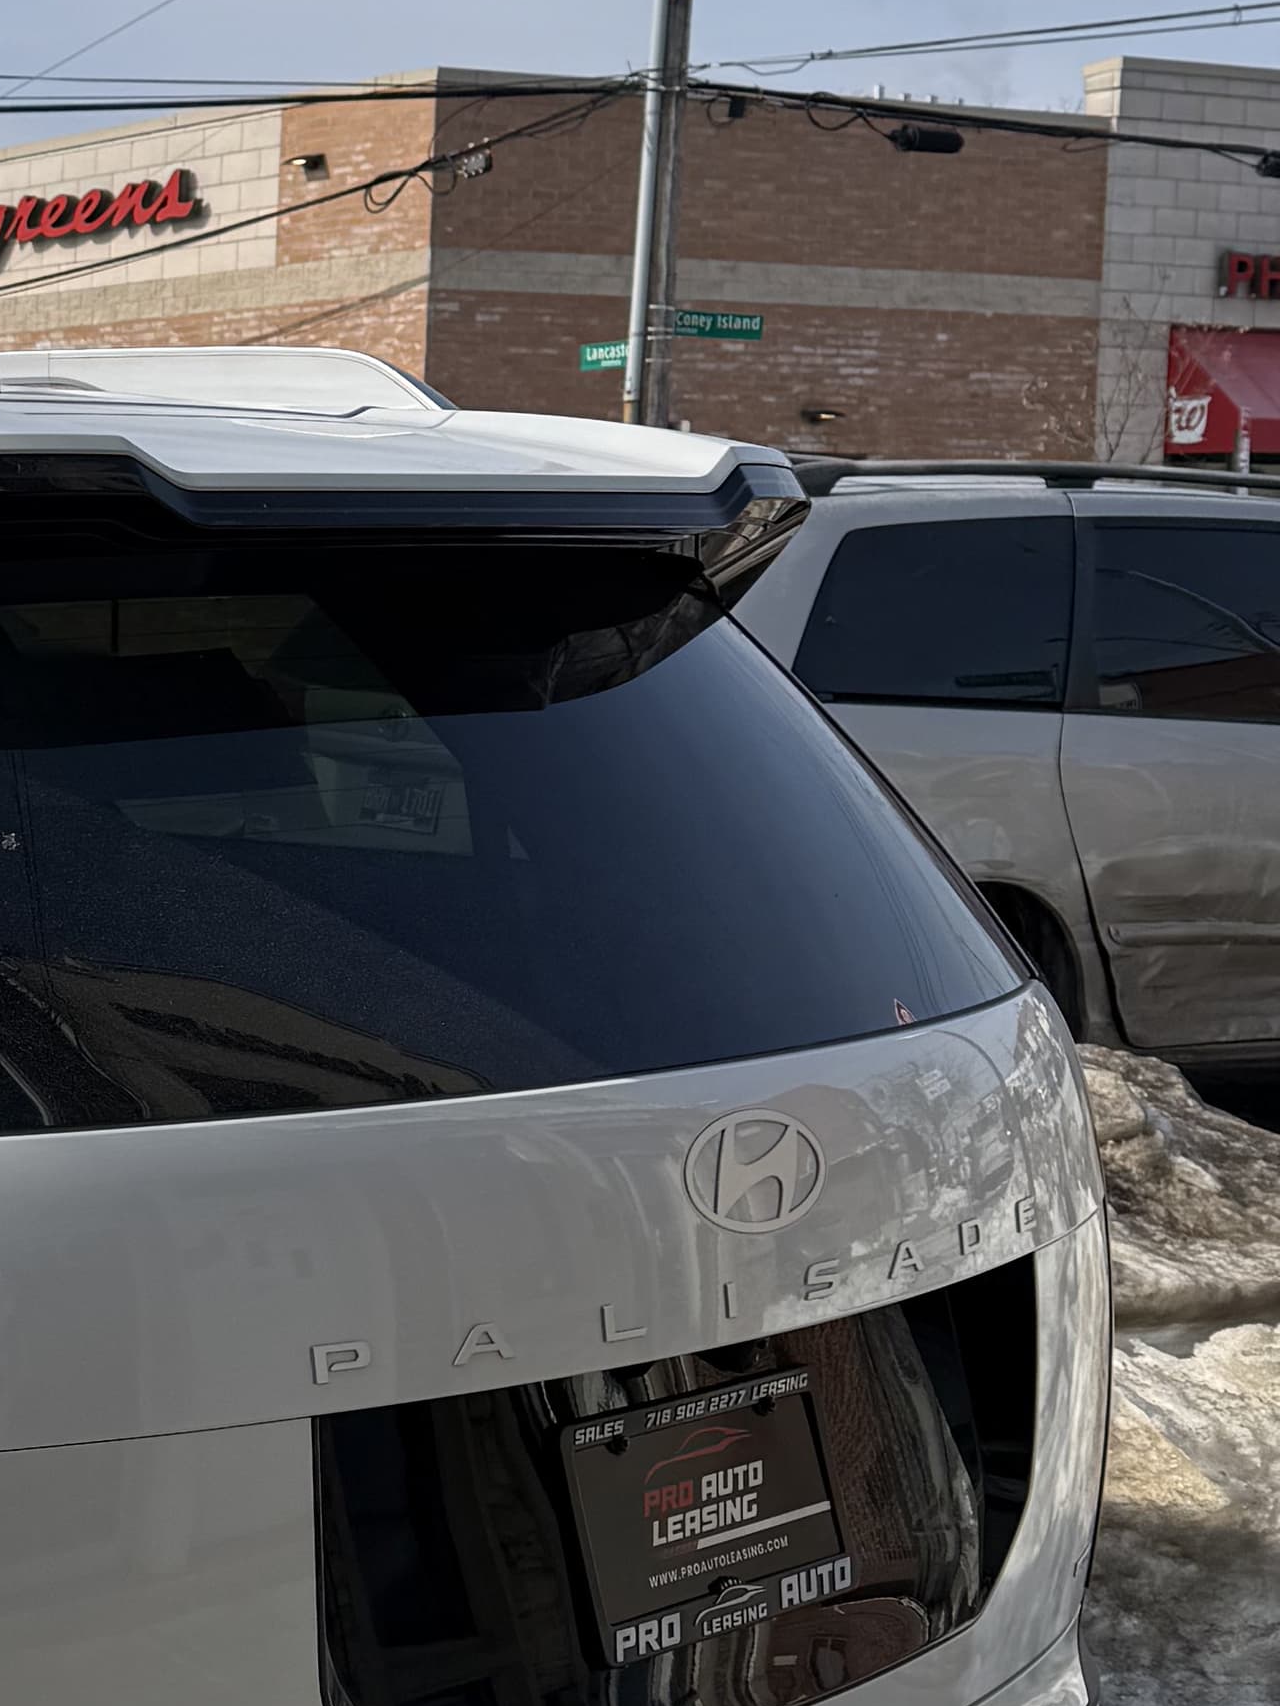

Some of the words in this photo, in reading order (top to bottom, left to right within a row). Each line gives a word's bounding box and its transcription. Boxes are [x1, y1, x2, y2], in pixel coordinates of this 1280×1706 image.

[676, 311, 713, 331] Coney
[717, 314, 761, 331] Island
[311, 1194, 1037, 1384] PALISADE
[575, 1419, 624, 1445] SALES
[645, 1410, 671, 1429] 718
[675, 1400, 704, 1422] 902
[709, 1390, 746, 1413] 2277
[752, 1373, 808, 1401] LEASING
[643, 1480, 693, 1518] PRO
[701, 1460, 763, 1501] AUTO
[652, 1492, 758, 1547] LEASING
[648, 1535, 789, 1588] WWW.PROAUTOLEASING.COM
[616, 1612, 681, 1662] PRO
[703, 1602, 767, 1636] LEASING
[780, 1556, 851, 1609] AUTO
